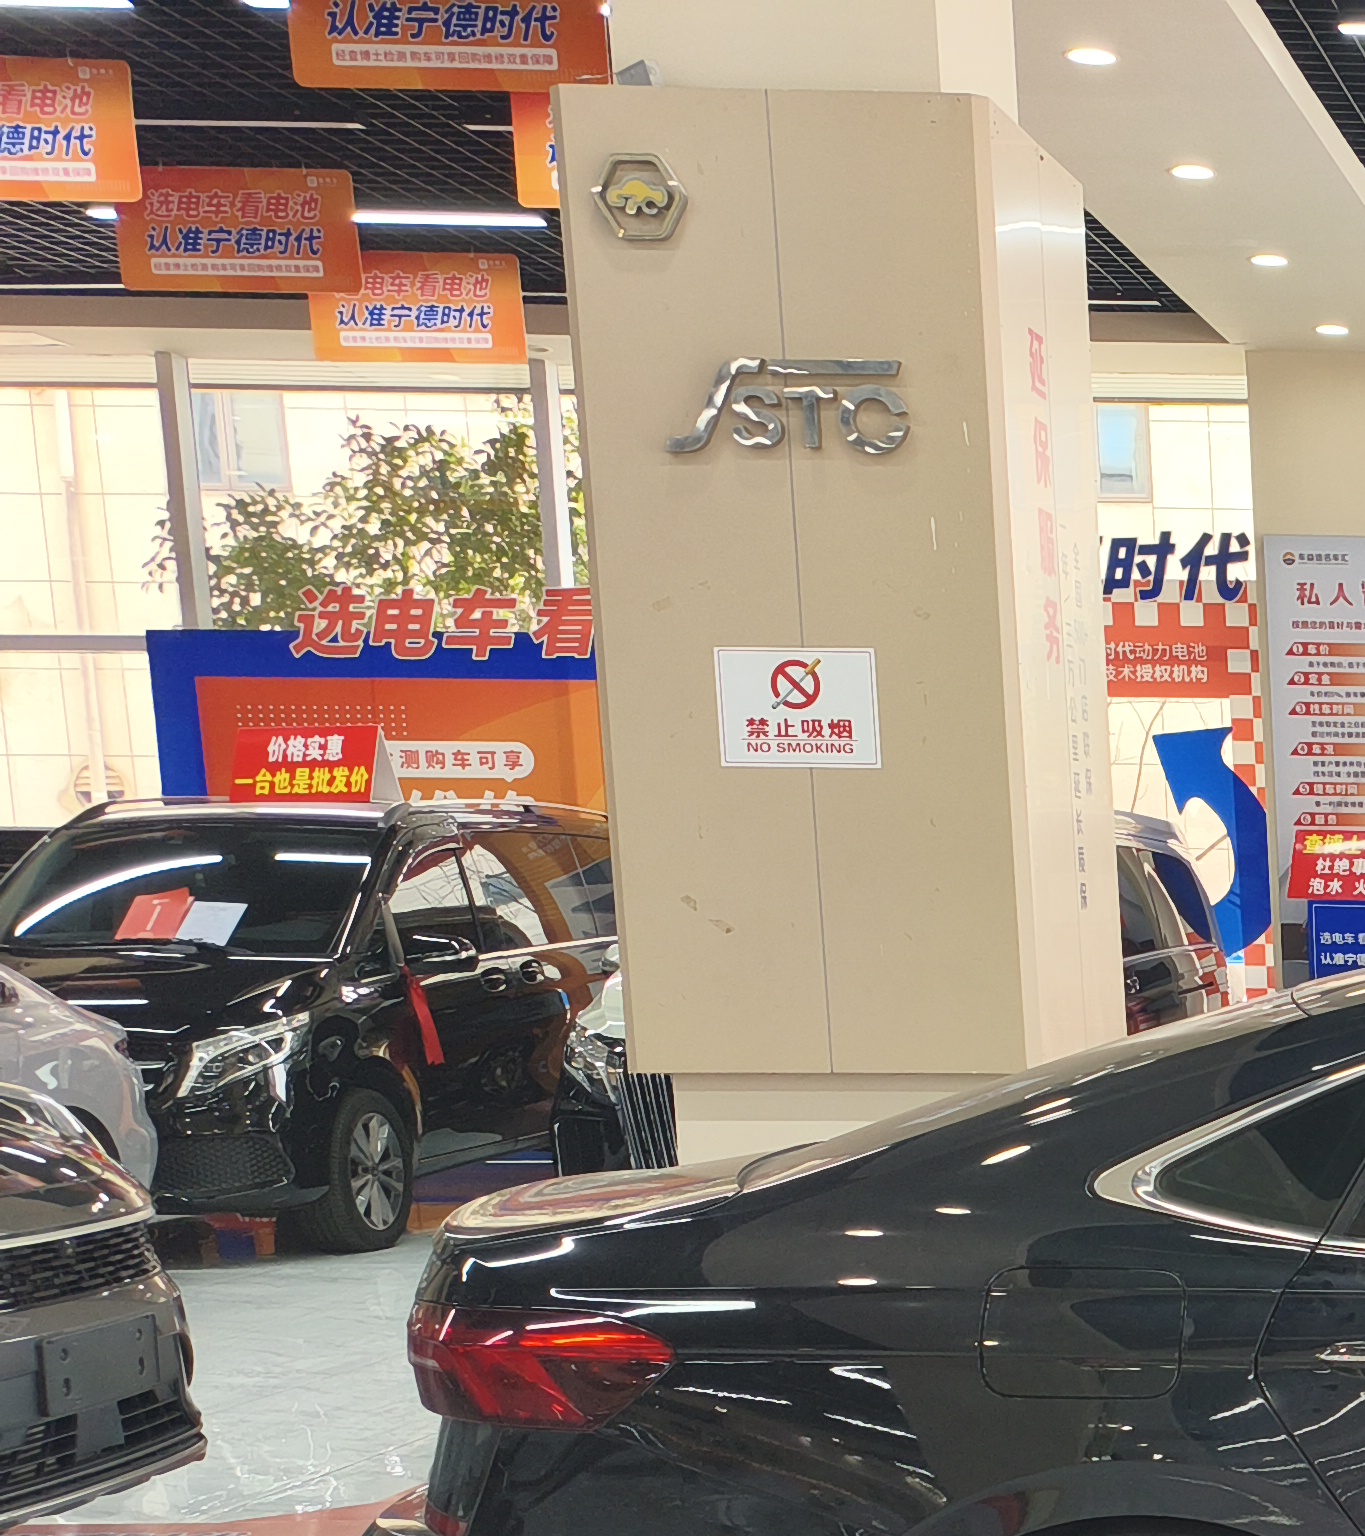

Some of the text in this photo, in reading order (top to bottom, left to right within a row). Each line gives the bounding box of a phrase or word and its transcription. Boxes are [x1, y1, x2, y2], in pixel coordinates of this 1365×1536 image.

[326, 0, 559, 43] 认准宁德时代
[0, 82, 93, 117] 看电池
[0, 123, 95, 158] 德时代
[147, 225, 323, 256] 认准宁德时代
[337, 303, 492, 330] 认准宁德时代
[1102, 531, 1250, 601] 时代
[746, 717, 853, 739] 禁止吸烟
[267, 734, 345, 762] 价格实惠
[389, 750, 524, 771] 测购车可享
[747, 742, 854, 754] NO SMOKING
[235, 766, 369, 796] 一台也是批发价
[1308, 878, 1343, 895] 泡水
